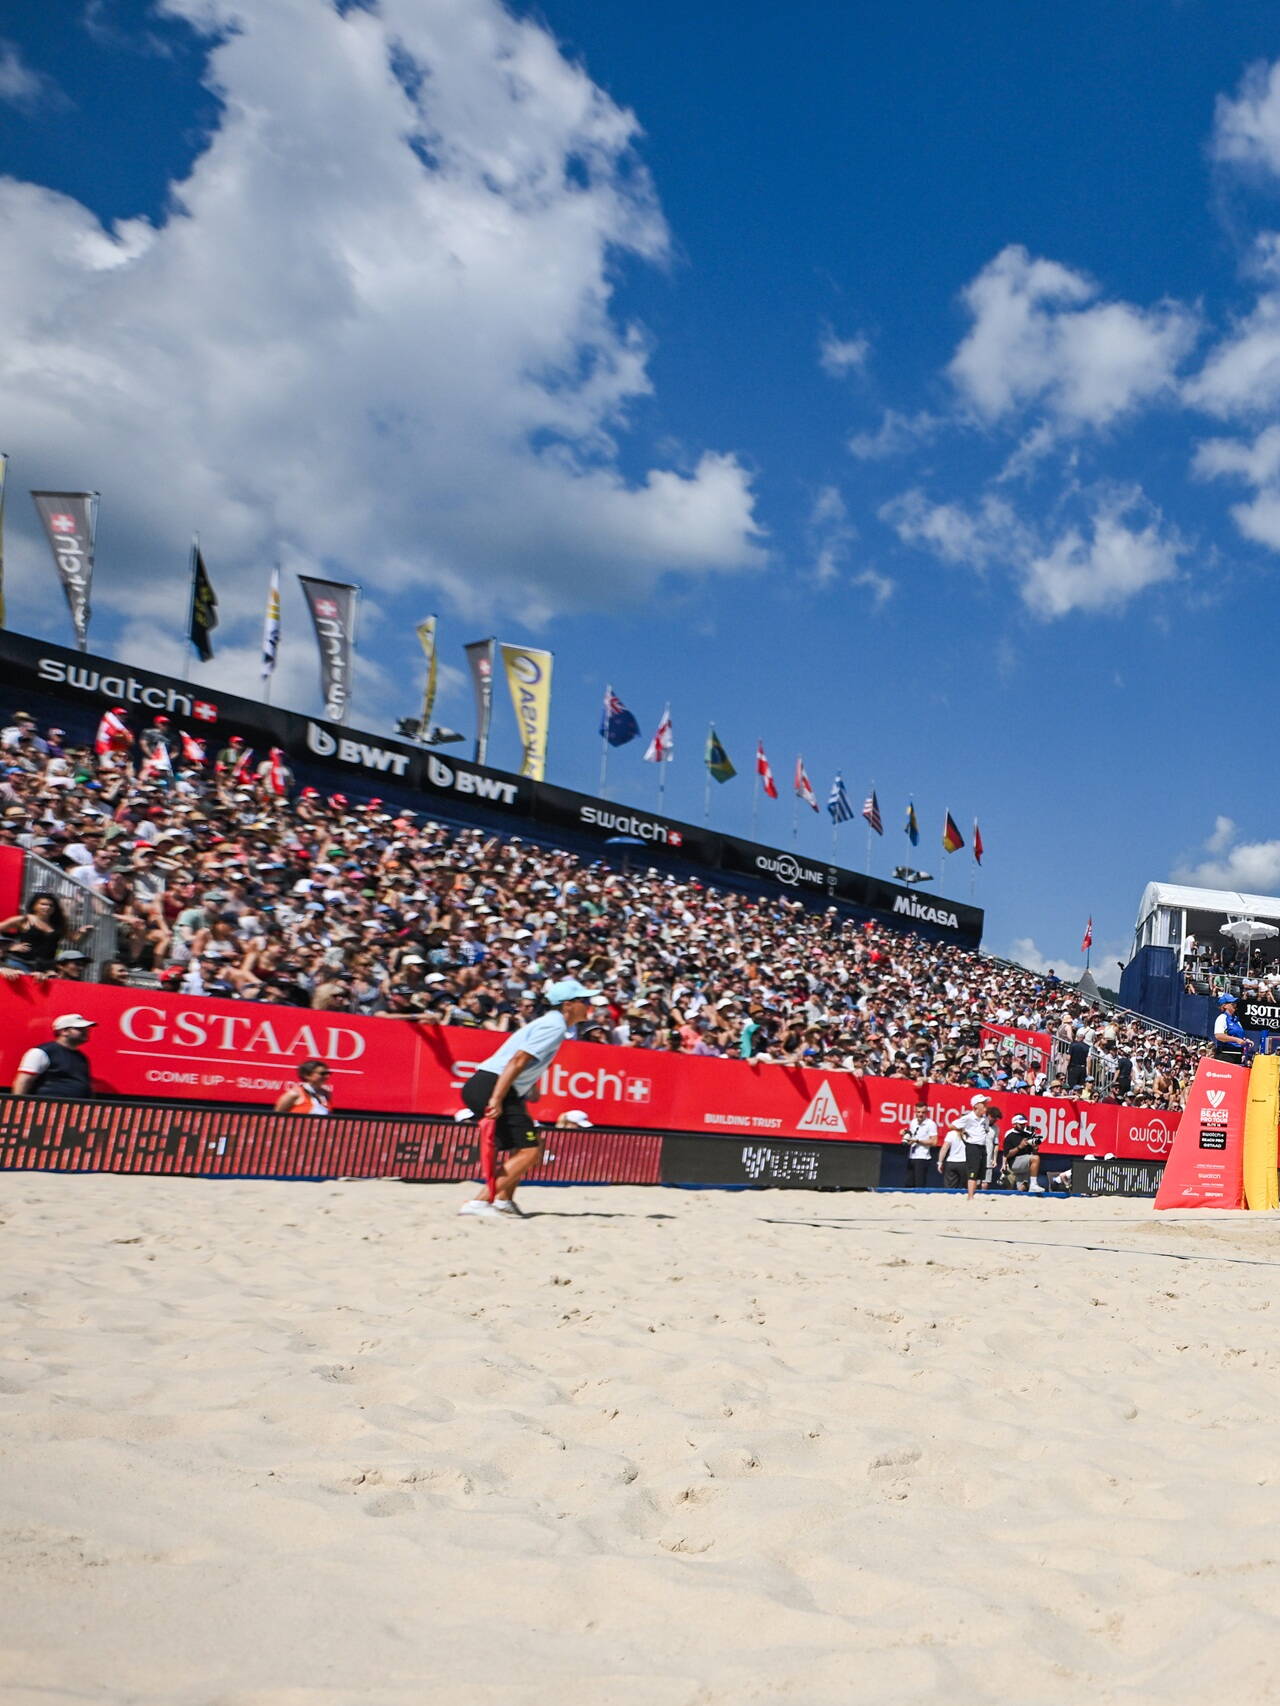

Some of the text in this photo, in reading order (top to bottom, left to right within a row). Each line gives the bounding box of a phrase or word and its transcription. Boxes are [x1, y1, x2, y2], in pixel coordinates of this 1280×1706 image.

[38, 658, 192, 716] swatch
[338, 738, 410, 776] BWT
[455, 770, 518, 804] BWT
[580, 806, 668, 843] swatch
[119, 1005, 366, 1061] GSTAAD
[146, 1070, 199, 1085] COME
[202, 1075, 225, 1085] UP
[237, 1077, 283, 1090] SLOW
[704, 1113, 783, 1128] BUILDING TRUST
[805, 1097, 839, 1126] Sika
[1029, 1107, 1096, 1147] Blick
